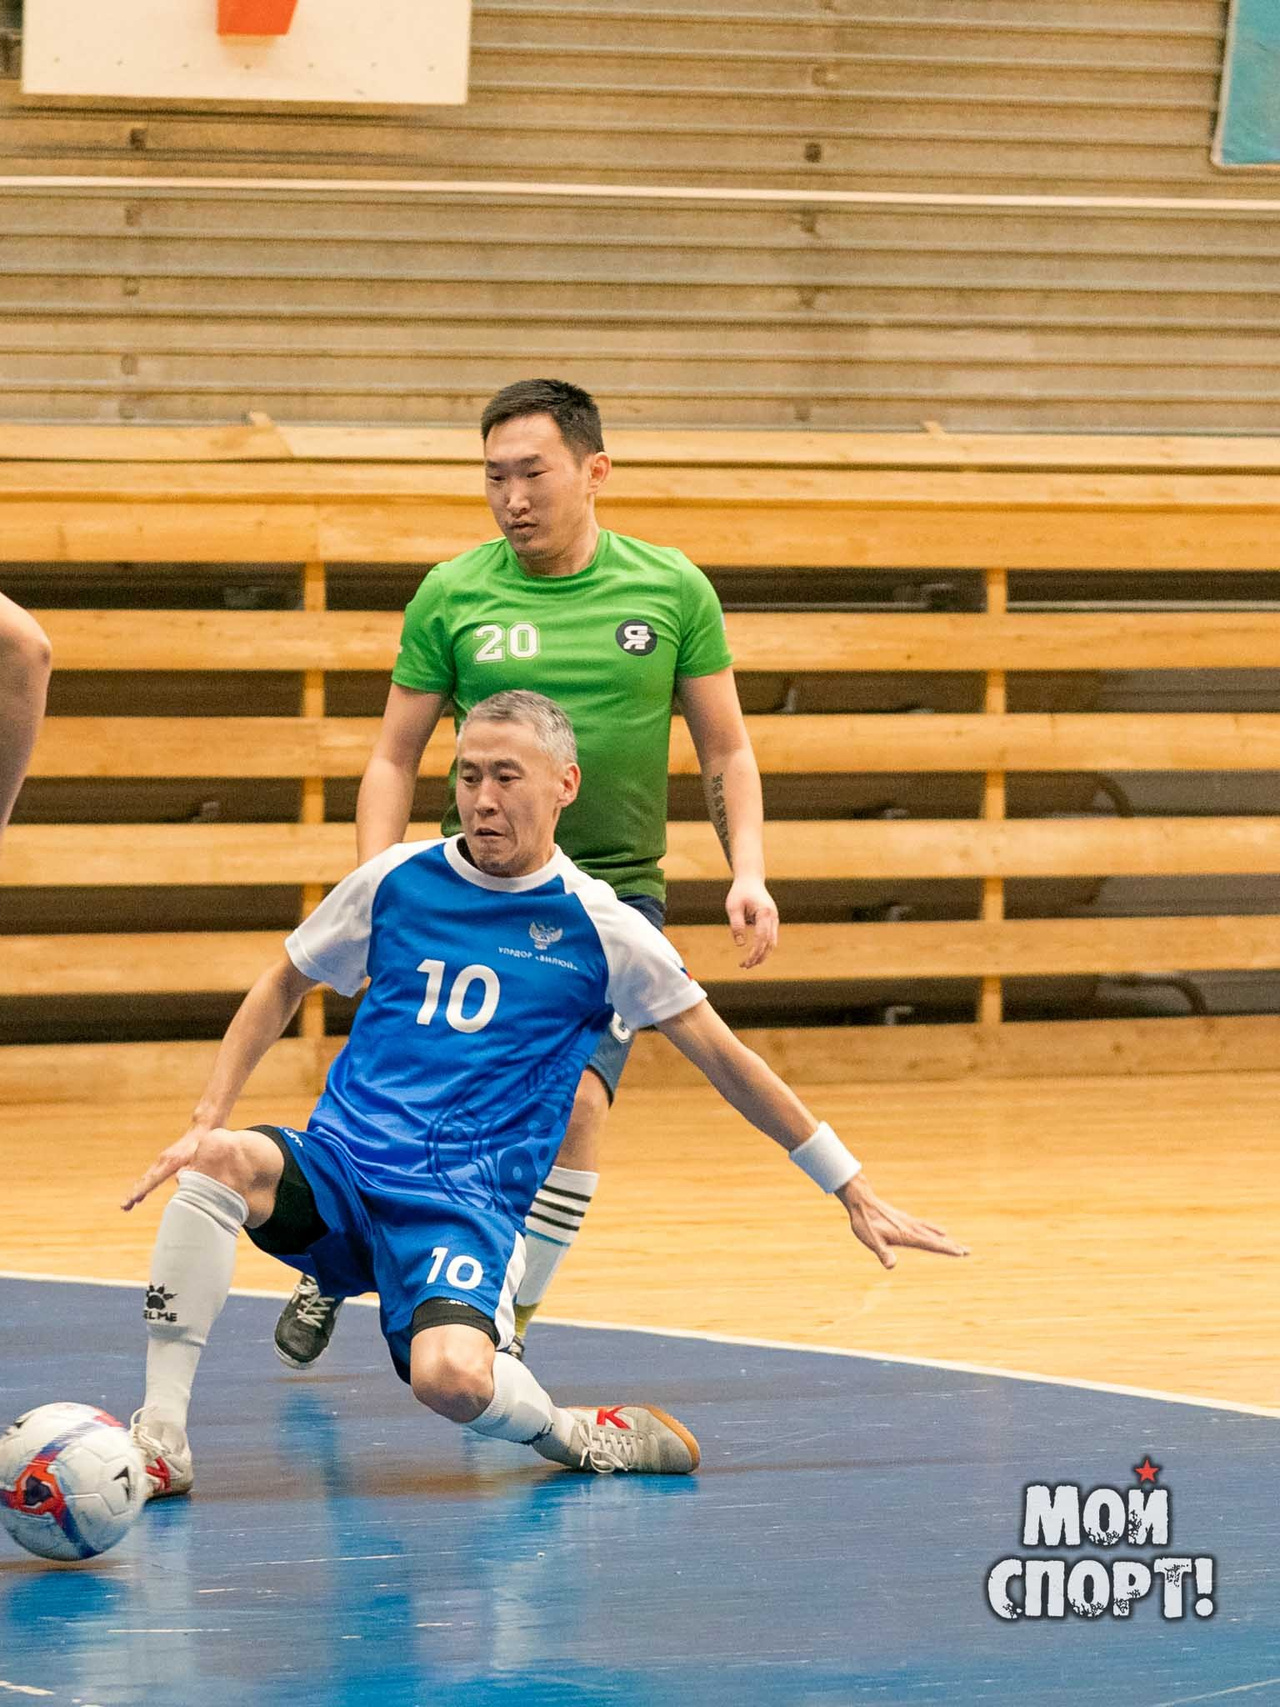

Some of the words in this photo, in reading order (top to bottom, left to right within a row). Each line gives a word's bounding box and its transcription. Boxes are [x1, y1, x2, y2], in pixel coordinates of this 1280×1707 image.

[473, 621, 540, 665] 20
[416, 958, 501, 1034] 10
[426, 1246, 484, 1290] 10
